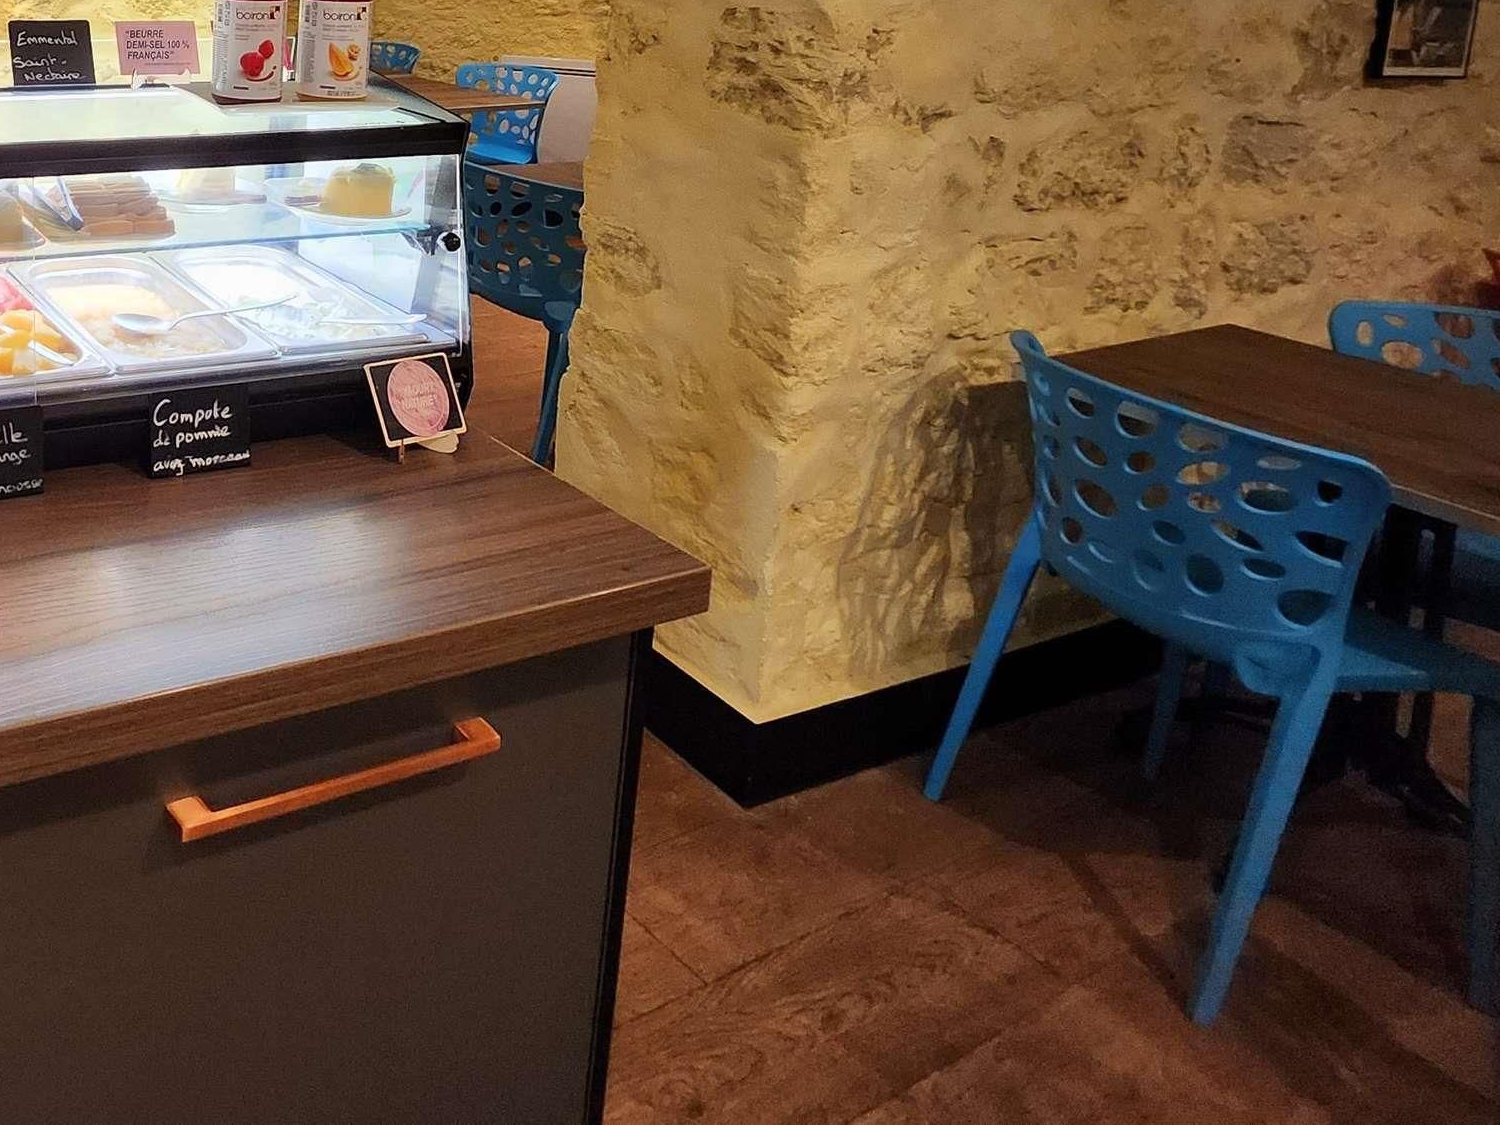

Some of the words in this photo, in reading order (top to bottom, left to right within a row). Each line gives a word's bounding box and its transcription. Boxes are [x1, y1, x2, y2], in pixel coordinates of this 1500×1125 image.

[236, 7, 269, 21] boiron
[323, 10, 357, 21] boiron
[16, 30, 78, 47] Emmental
[126, 40, 165, 50] DEMI-SEL
[167, 40, 181, 49] 100
[182, 40, 190, 49] %
[153, 398, 234, 428] Compote
